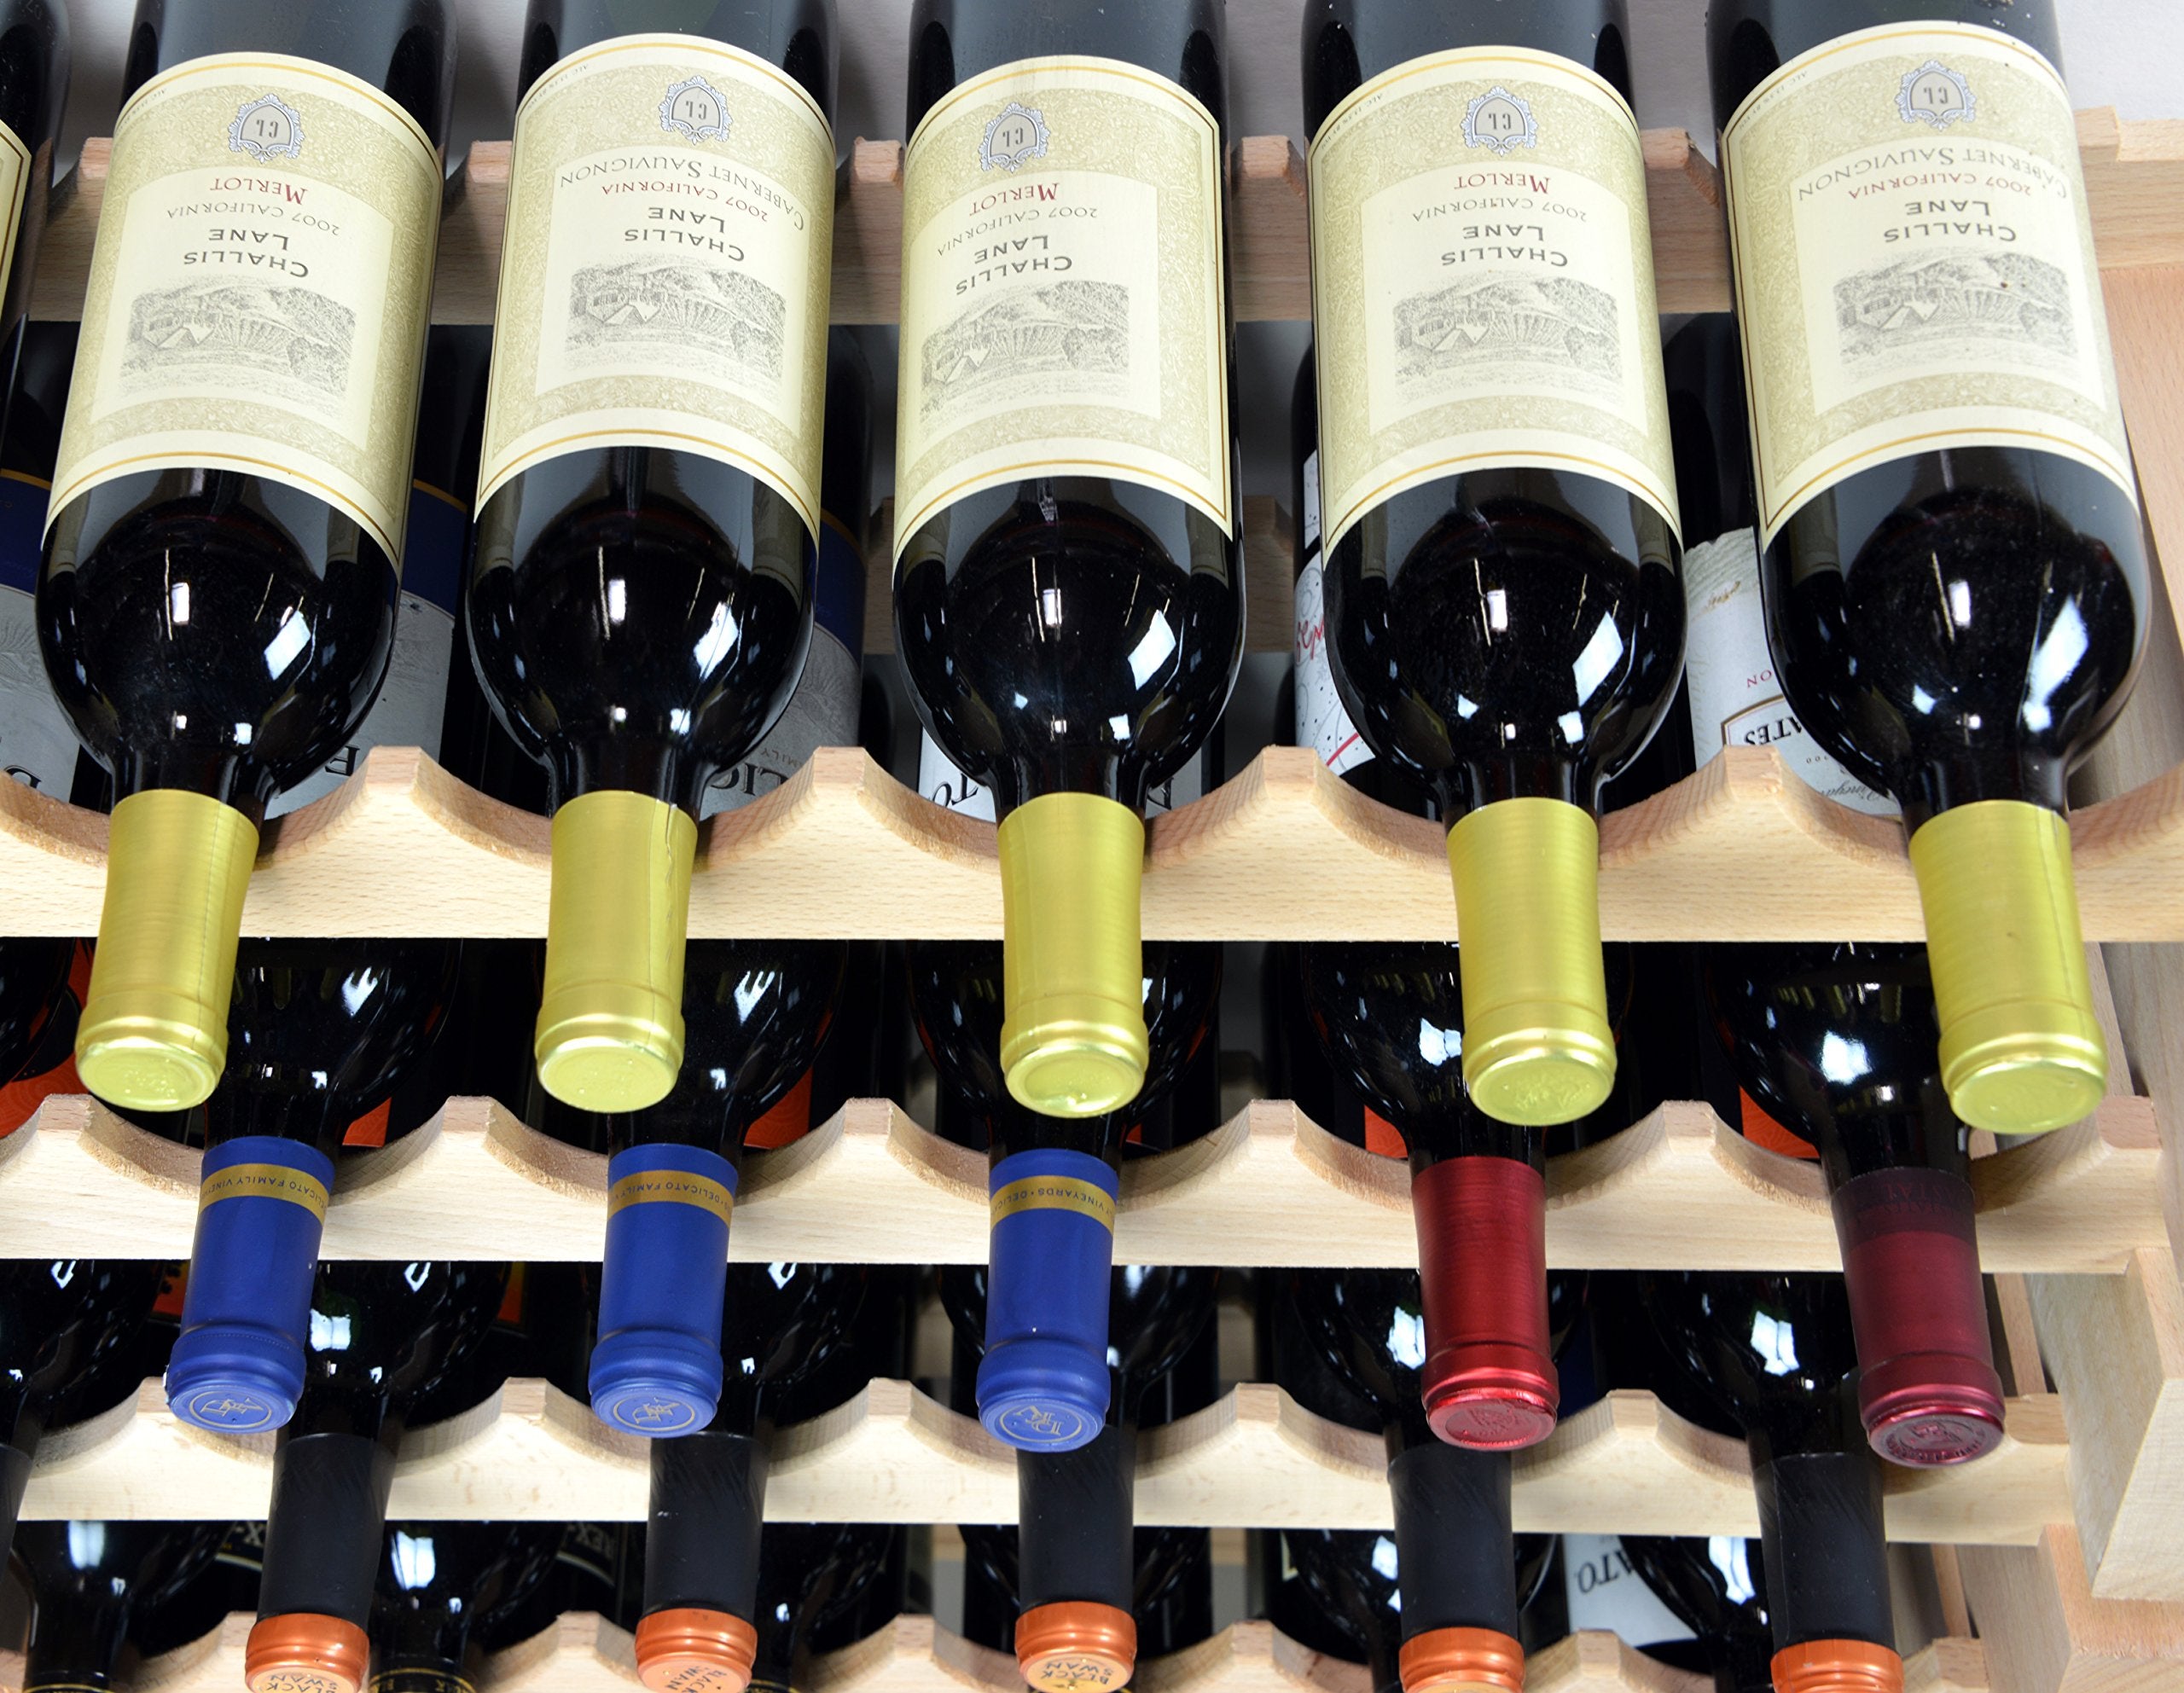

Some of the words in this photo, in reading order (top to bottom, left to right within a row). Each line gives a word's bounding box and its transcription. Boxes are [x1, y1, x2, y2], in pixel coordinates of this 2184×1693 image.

[559, 156, 703, 188] SAUVIGNON
[1454, 172, 1550, 194] MERLOT
[1797, 146, 1955, 200] SAUVIGNON
[1962, 148, 2067, 197] CABERNET
[210, 177, 307, 205] MERLOT
[601, 181, 718, 200] CALIFORNIA
[708, 164, 804, 230] CABERNET
[1848, 171, 1977, 200] CALIFORNIA
[1984, 177, 2031, 194] 2007
[166, 201, 283, 219] CALIFORNIA
[724, 195, 769, 222] 2007
[969, 183, 1060, 215] MERLOT
[1412, 197, 1533, 222] CALIFORNIA
[1904, 200, 1989, 216] LANE
[292, 212, 340, 236] 2007
[648, 207, 725, 234] LANE
[1048, 207, 1098, 218] 2007
[1542, 203, 1587, 222] 2007
[208, 229, 289, 251] LANE
[937, 208, 1039, 256] CALIFORNIA
[1462, 224, 1544, 241] LANE
[1882, 222, 2017, 242] CHALLIS
[624, 229, 745, 262] CHALLIS
[974, 235, 1049, 264] LANE
[1440, 247, 1567, 267] CHALLIS
[183, 251, 308, 278] CHALLIS
[956, 256, 1072, 295] CHALLIS
[236, 1176, 284, 1186] FAMILY
[665, 1182, 719, 1203] DELICATO
[289, 1180, 328, 1209] ELICATO
[1038, 1188, 1103, 1210] VINEYARDS
[1041, 1670, 1109, 1684] BLACK
[1045, 1661, 1113, 1675] SWAN
[270, 1674, 337, 1690] SWAN
